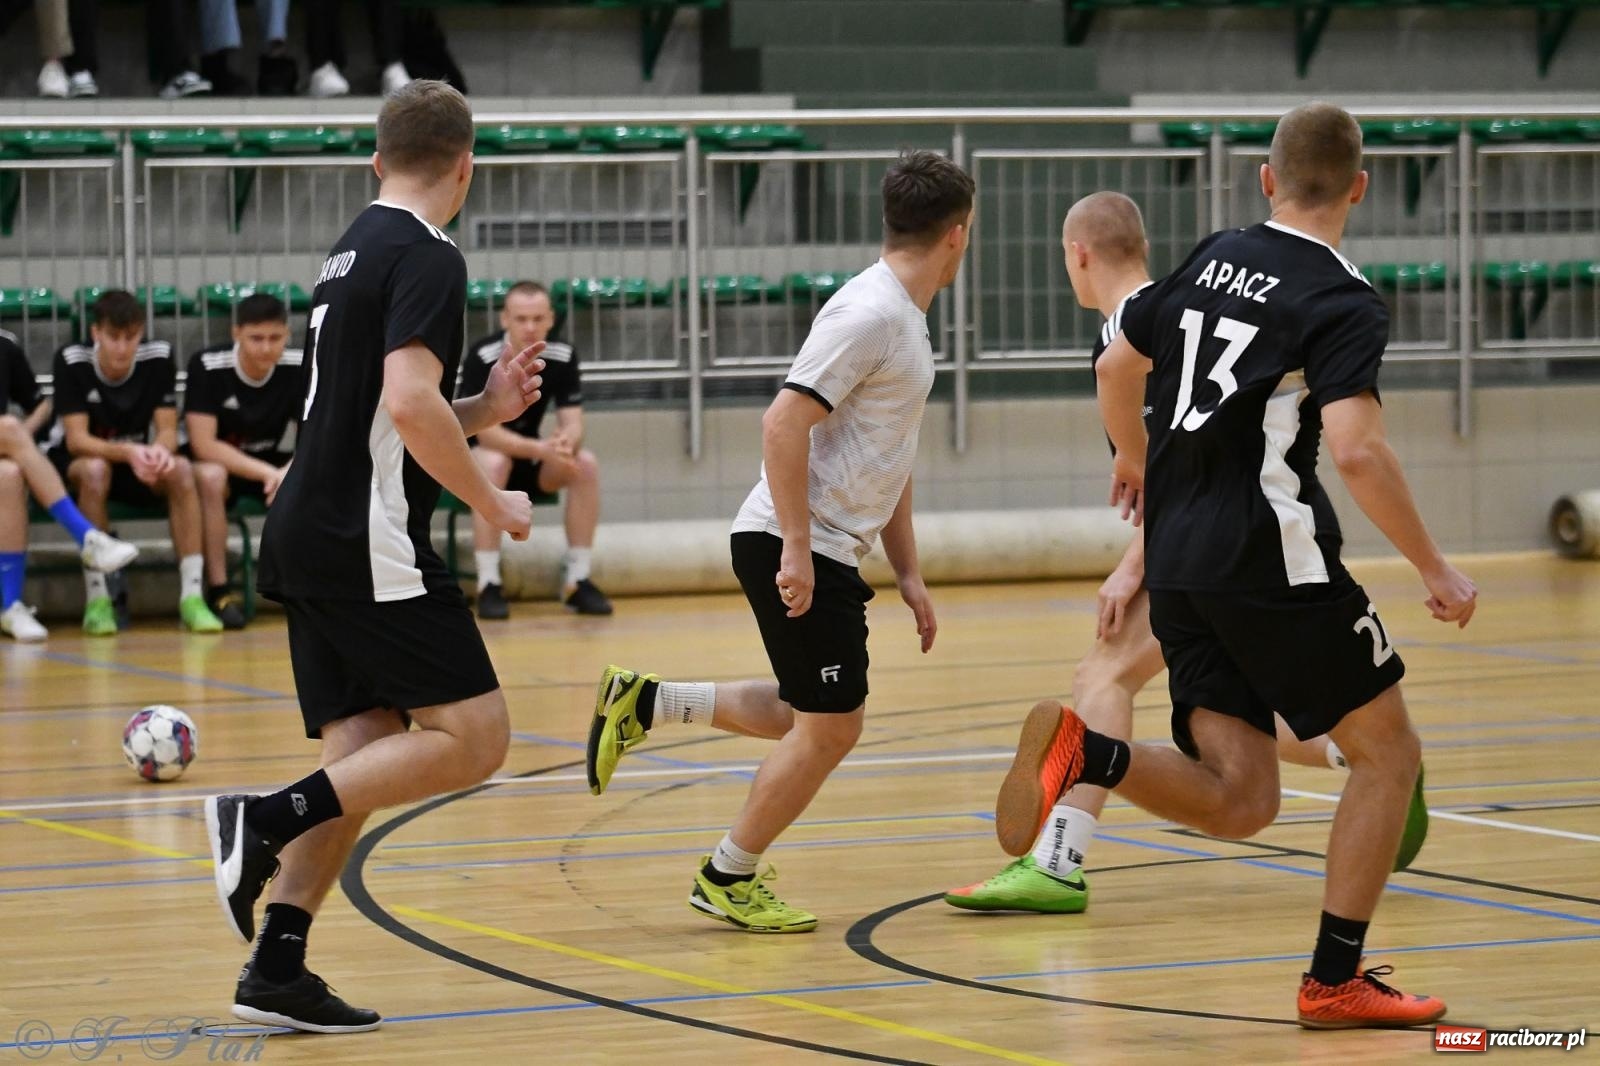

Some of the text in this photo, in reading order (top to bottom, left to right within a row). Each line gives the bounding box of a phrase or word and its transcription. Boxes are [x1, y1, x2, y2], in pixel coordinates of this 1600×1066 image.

[314, 250, 357, 287] AWID
[1195, 259, 1281, 304] APACZ
[1169, 308, 1260, 432] 13
[1353, 603, 1394, 668] 2
